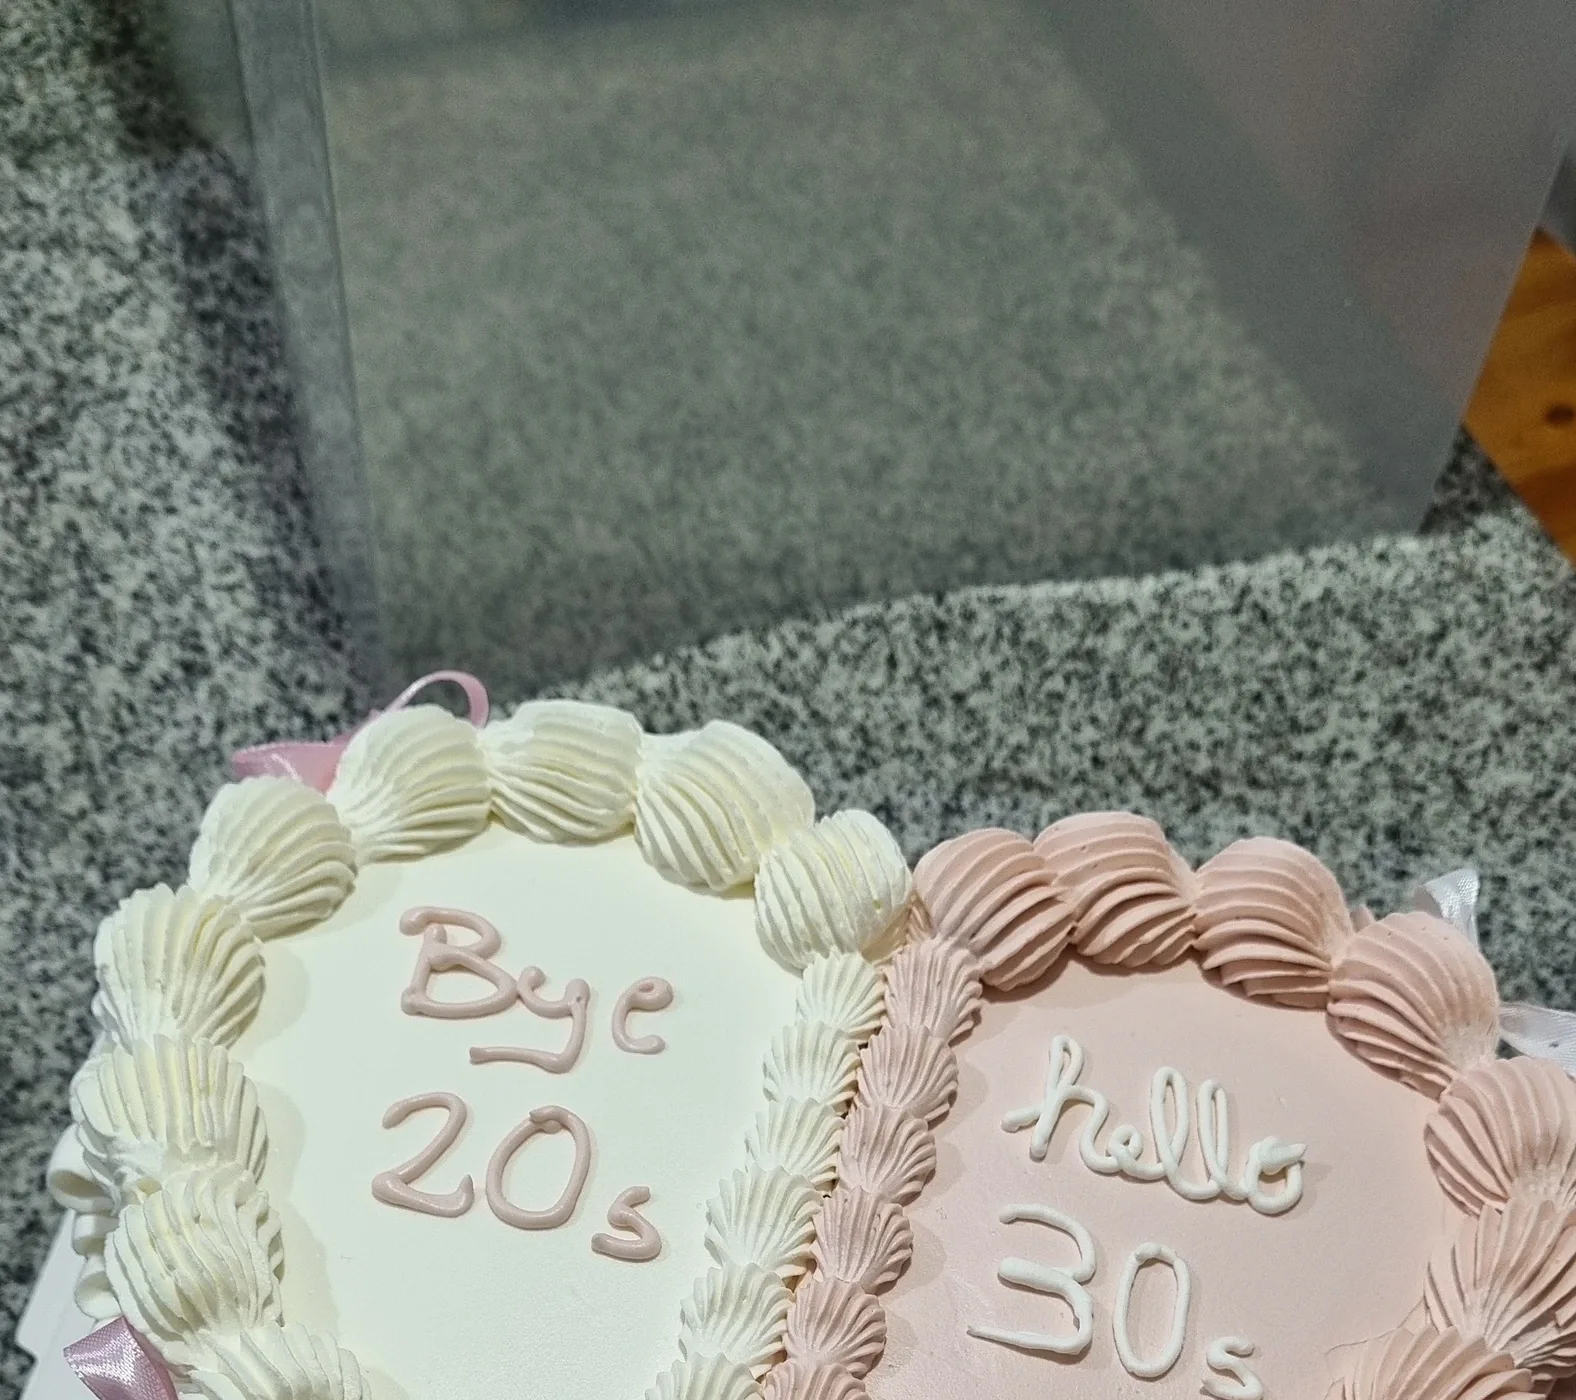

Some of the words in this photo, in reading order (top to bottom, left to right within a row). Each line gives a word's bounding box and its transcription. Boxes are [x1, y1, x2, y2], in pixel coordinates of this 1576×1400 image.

[399, 905, 675, 1074] Bye
[371, 1091, 663, 1262] 20s
[1001, 1034, 1308, 1216] hello
